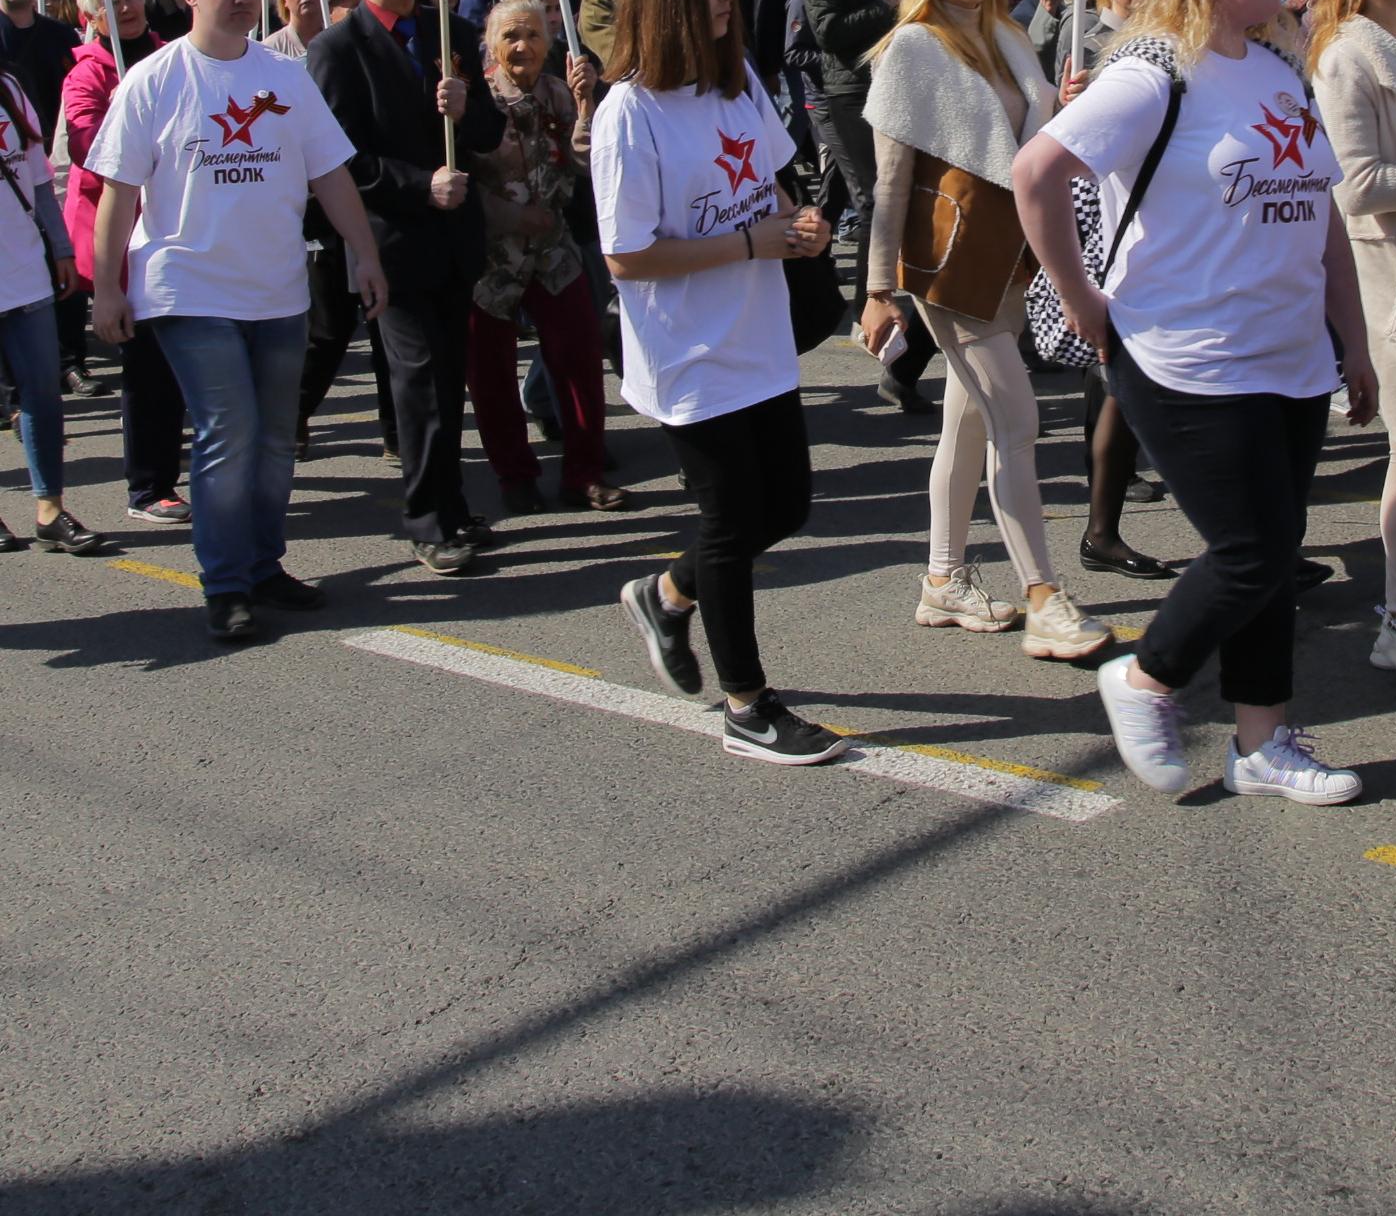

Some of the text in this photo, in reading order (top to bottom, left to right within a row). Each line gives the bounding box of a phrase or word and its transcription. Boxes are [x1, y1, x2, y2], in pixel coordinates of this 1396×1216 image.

[184, 138, 281, 174] Бессмертный
[214, 167, 265, 185] ПОЛК
[1261, 200, 1316, 224] ПОЛК
